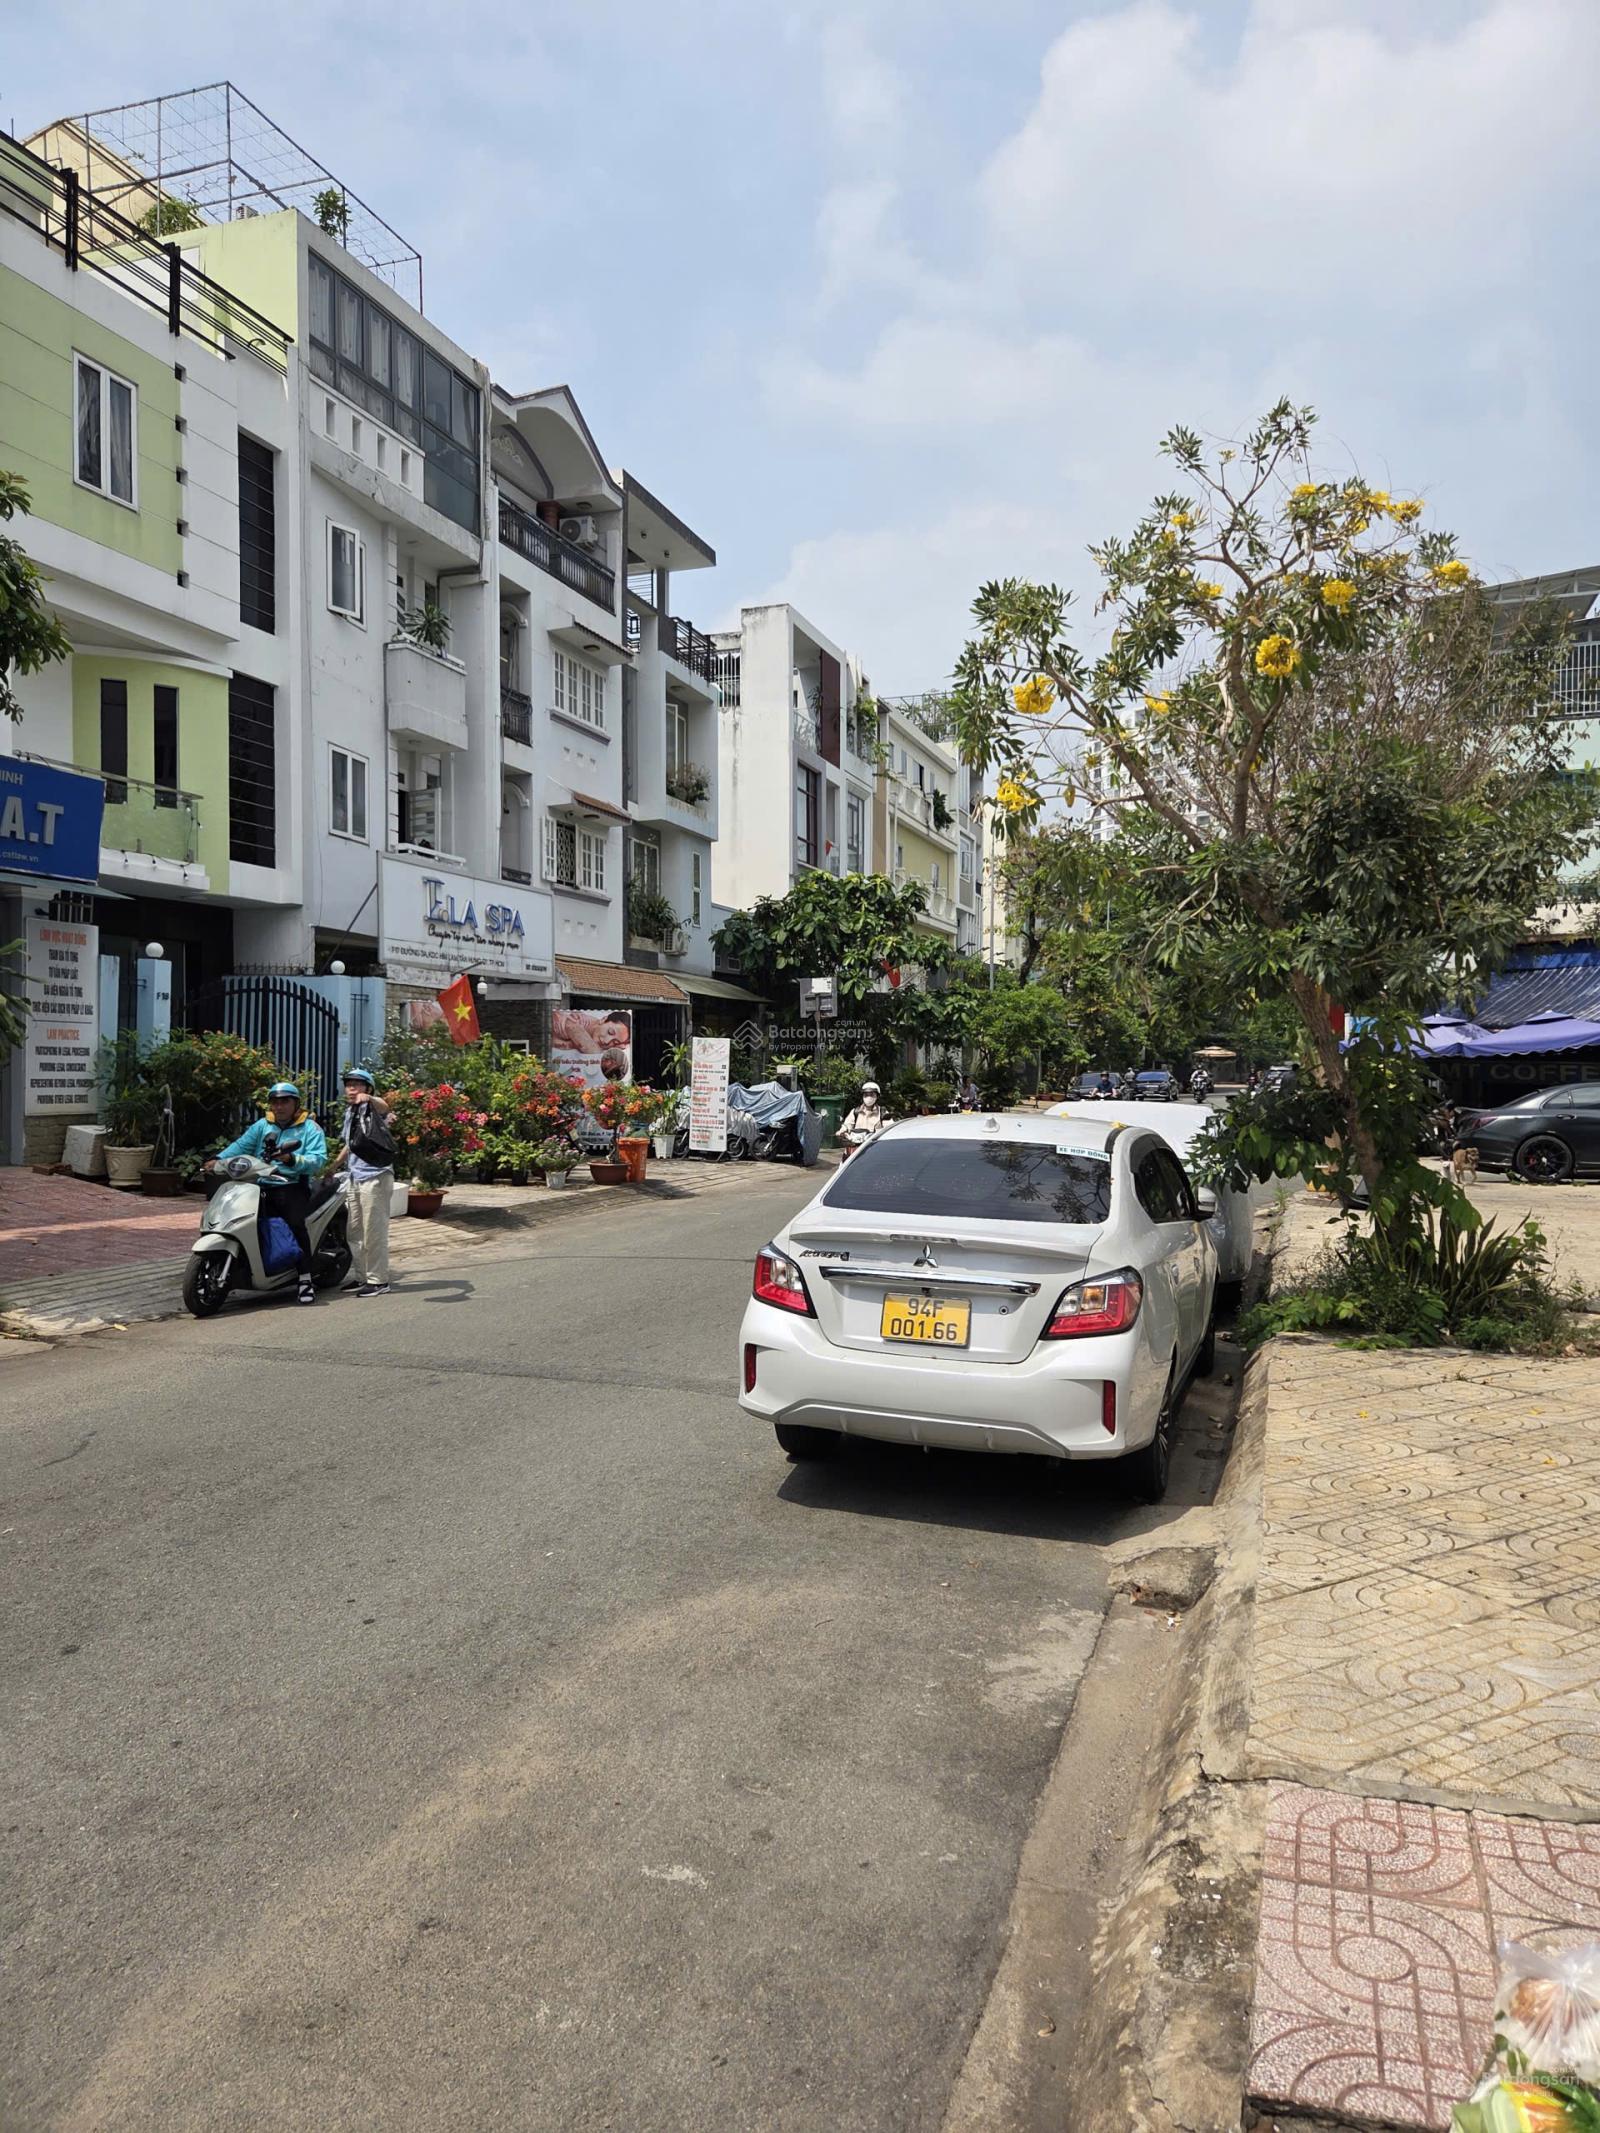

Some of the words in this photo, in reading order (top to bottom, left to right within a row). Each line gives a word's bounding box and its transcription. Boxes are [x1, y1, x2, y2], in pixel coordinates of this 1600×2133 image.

[0, 769, 24, 786] INH
[485, 903, 526, 937] SPA
[907, 1298, 945, 1318] 94F
[890, 1318, 959, 1341] 001.66
